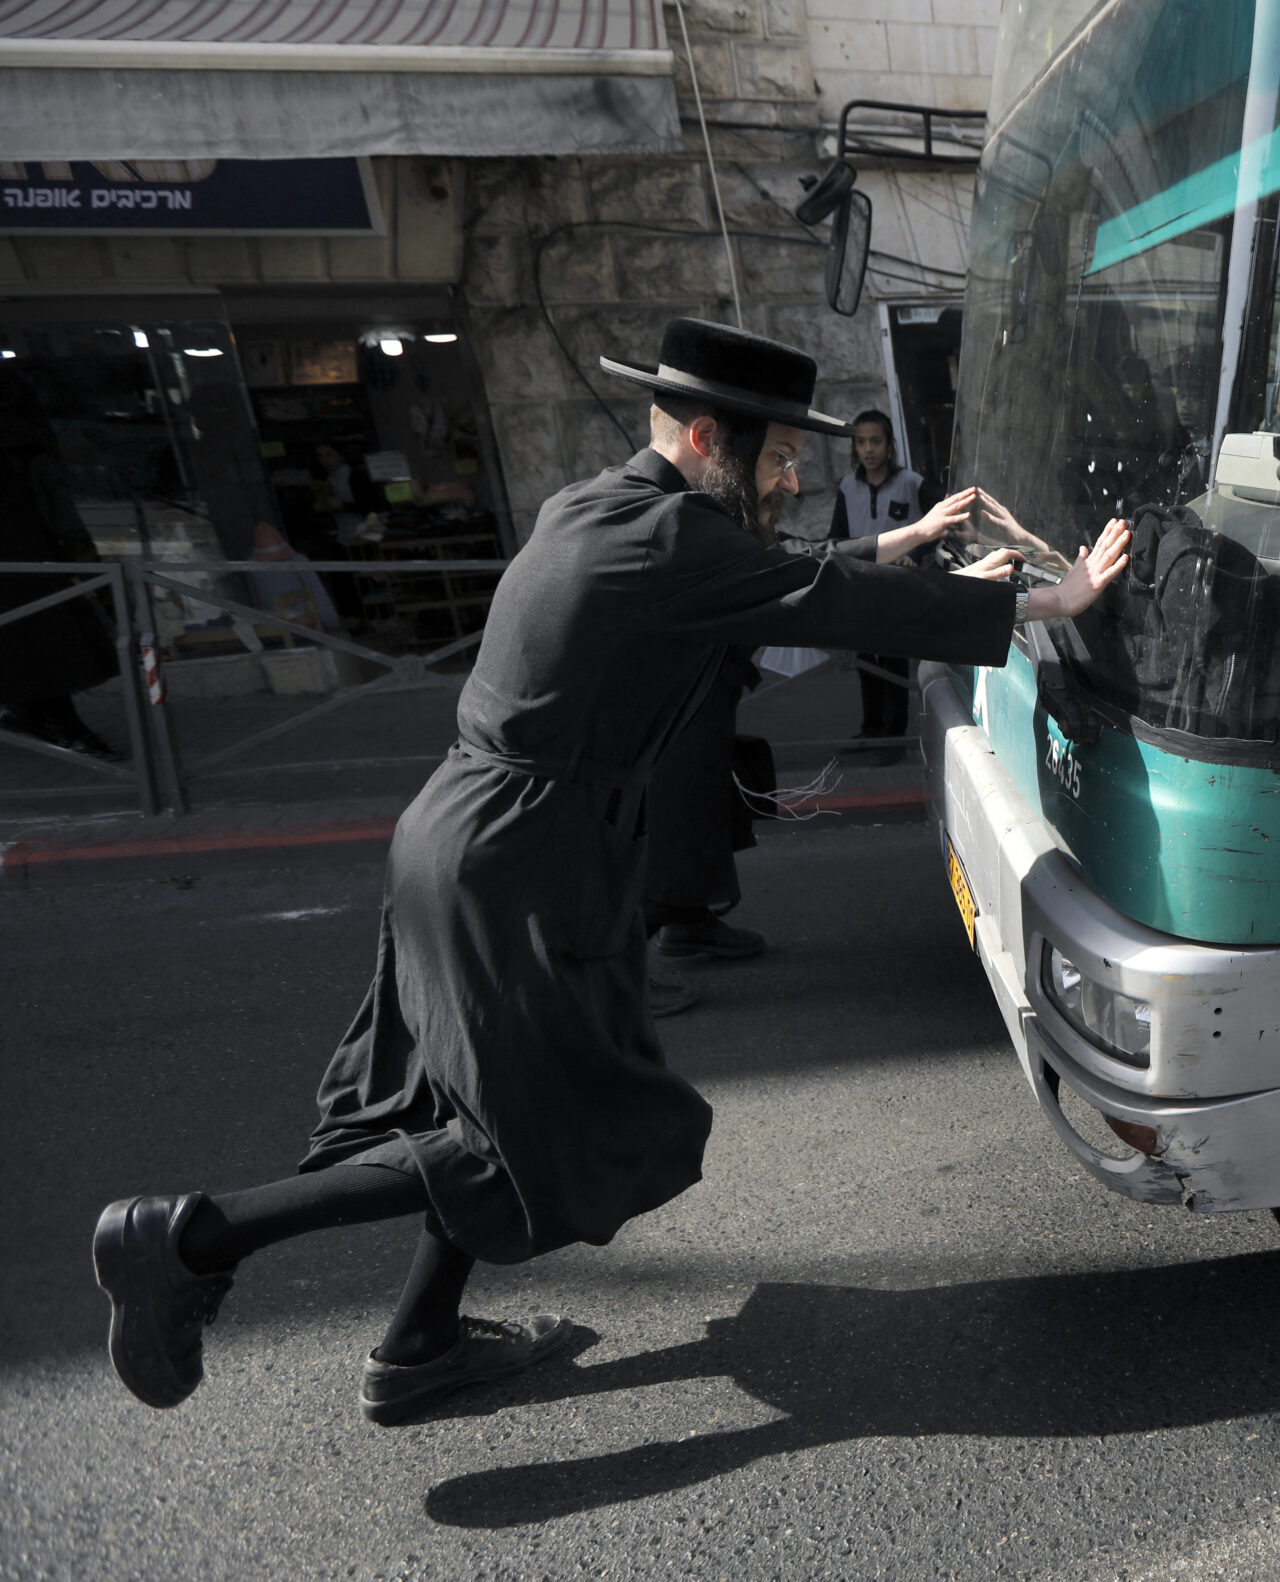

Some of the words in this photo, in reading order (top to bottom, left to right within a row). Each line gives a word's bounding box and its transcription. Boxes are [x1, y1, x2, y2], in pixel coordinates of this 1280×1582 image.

[3, 188, 82, 208] אופנה
[91, 189, 192, 209] מרכיבים
[1045, 733, 1082, 799] 26435
